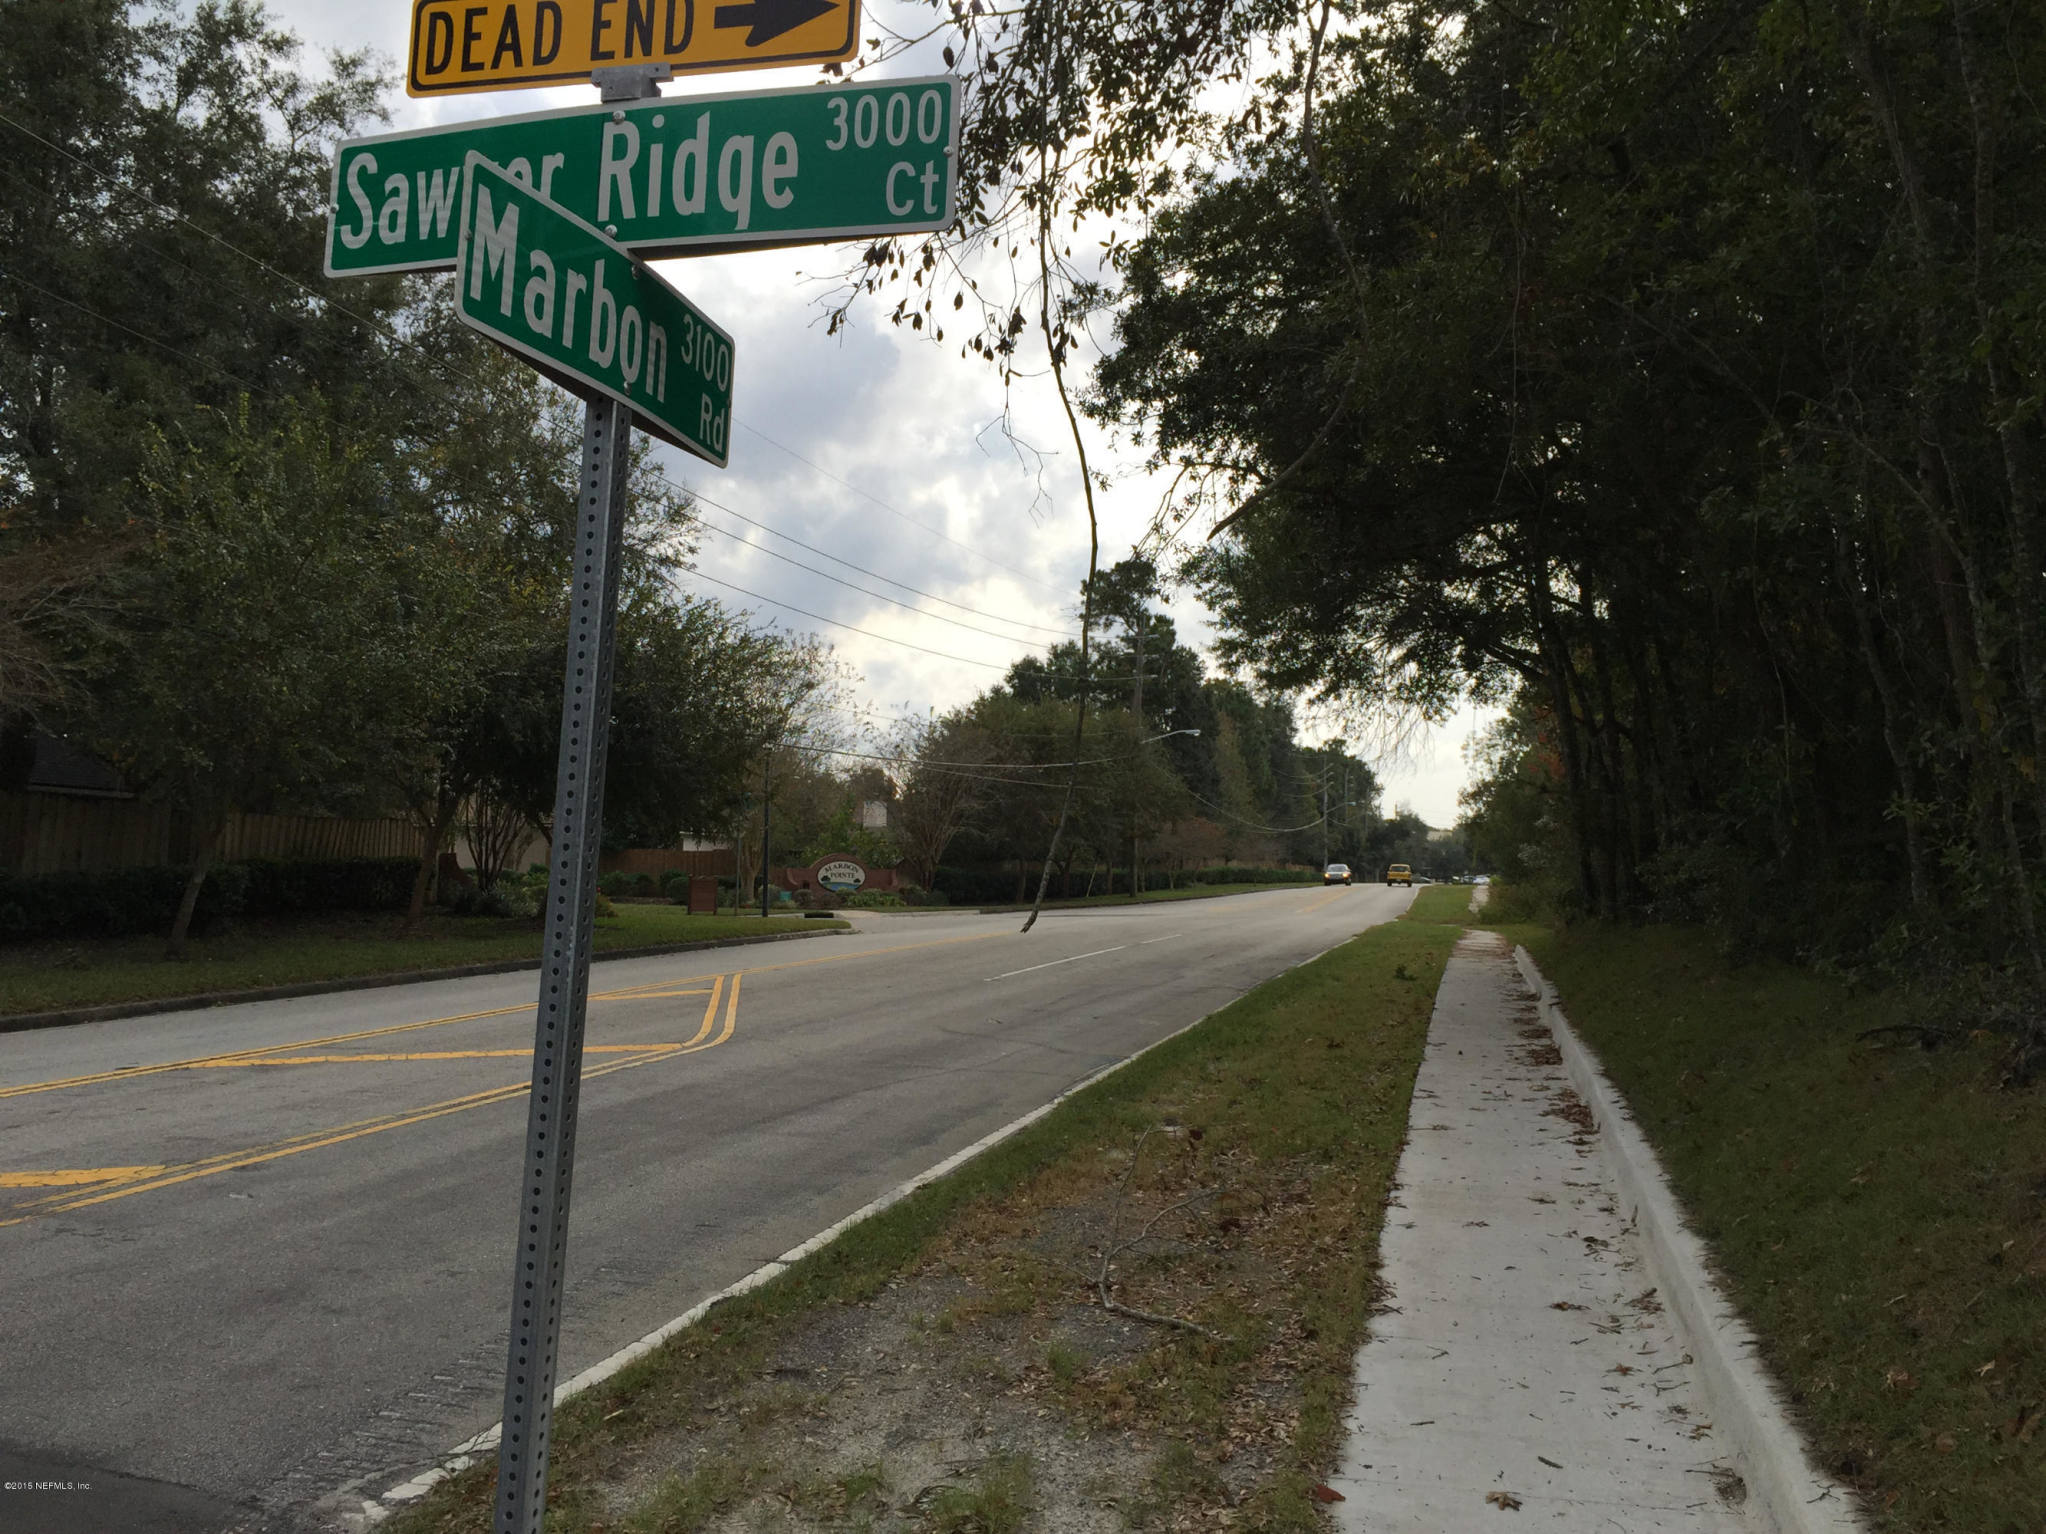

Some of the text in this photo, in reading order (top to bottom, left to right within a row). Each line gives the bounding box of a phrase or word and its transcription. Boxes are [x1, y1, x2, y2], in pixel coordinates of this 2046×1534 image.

[425, 0, 695, 76] DEAD END
[826, 89, 943, 152] 3000
[341, 111, 800, 250] Sawr Ridge
[885, 160, 940, 216] Ct
[470, 184, 667, 404] Marbon
[680, 313, 730, 393] 3100
[699, 392, 726, 453] Rd
